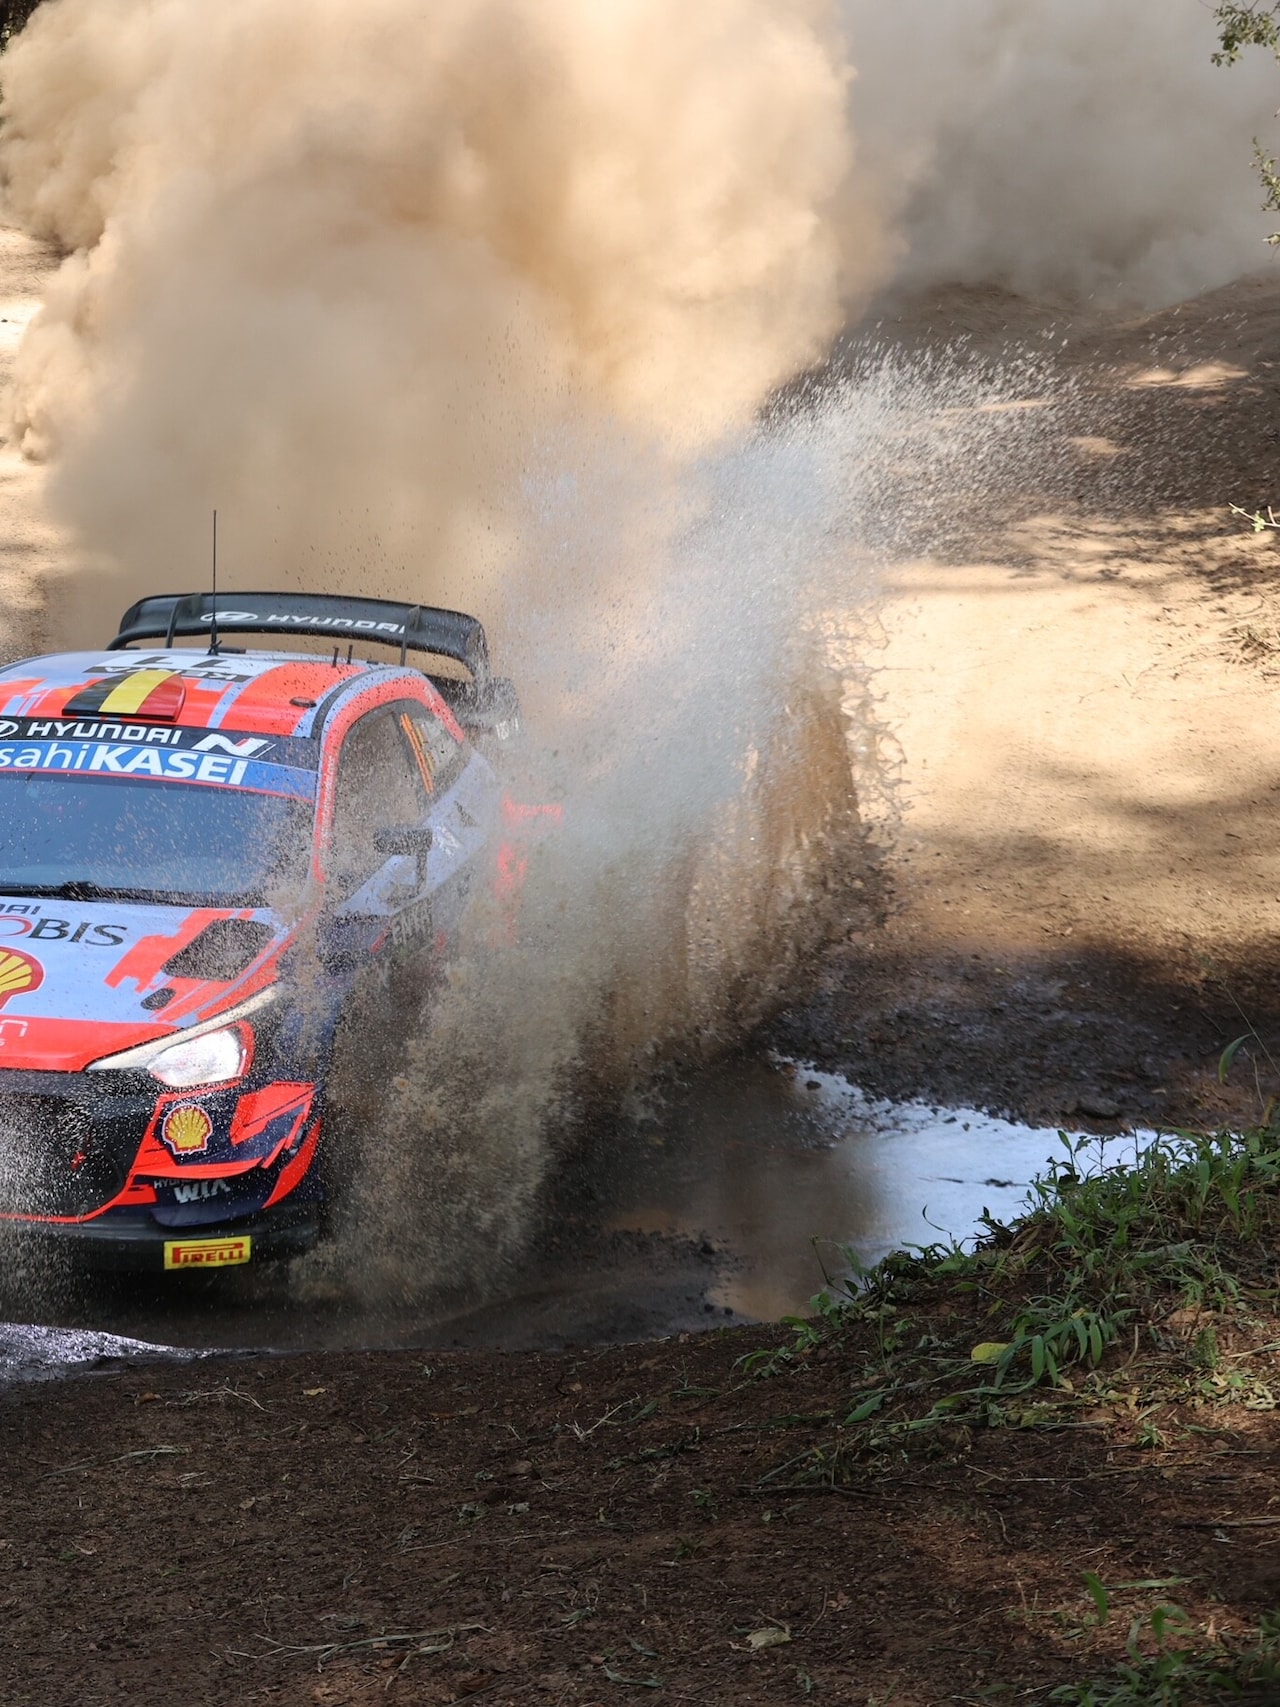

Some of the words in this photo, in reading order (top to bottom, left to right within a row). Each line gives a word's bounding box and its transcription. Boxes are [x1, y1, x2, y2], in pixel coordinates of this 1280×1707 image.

[267, 614, 406, 634] HYUNDAI
[26, 721, 183, 744] HYUNDAI
[172, 1242, 244, 1264] PIRELLI
